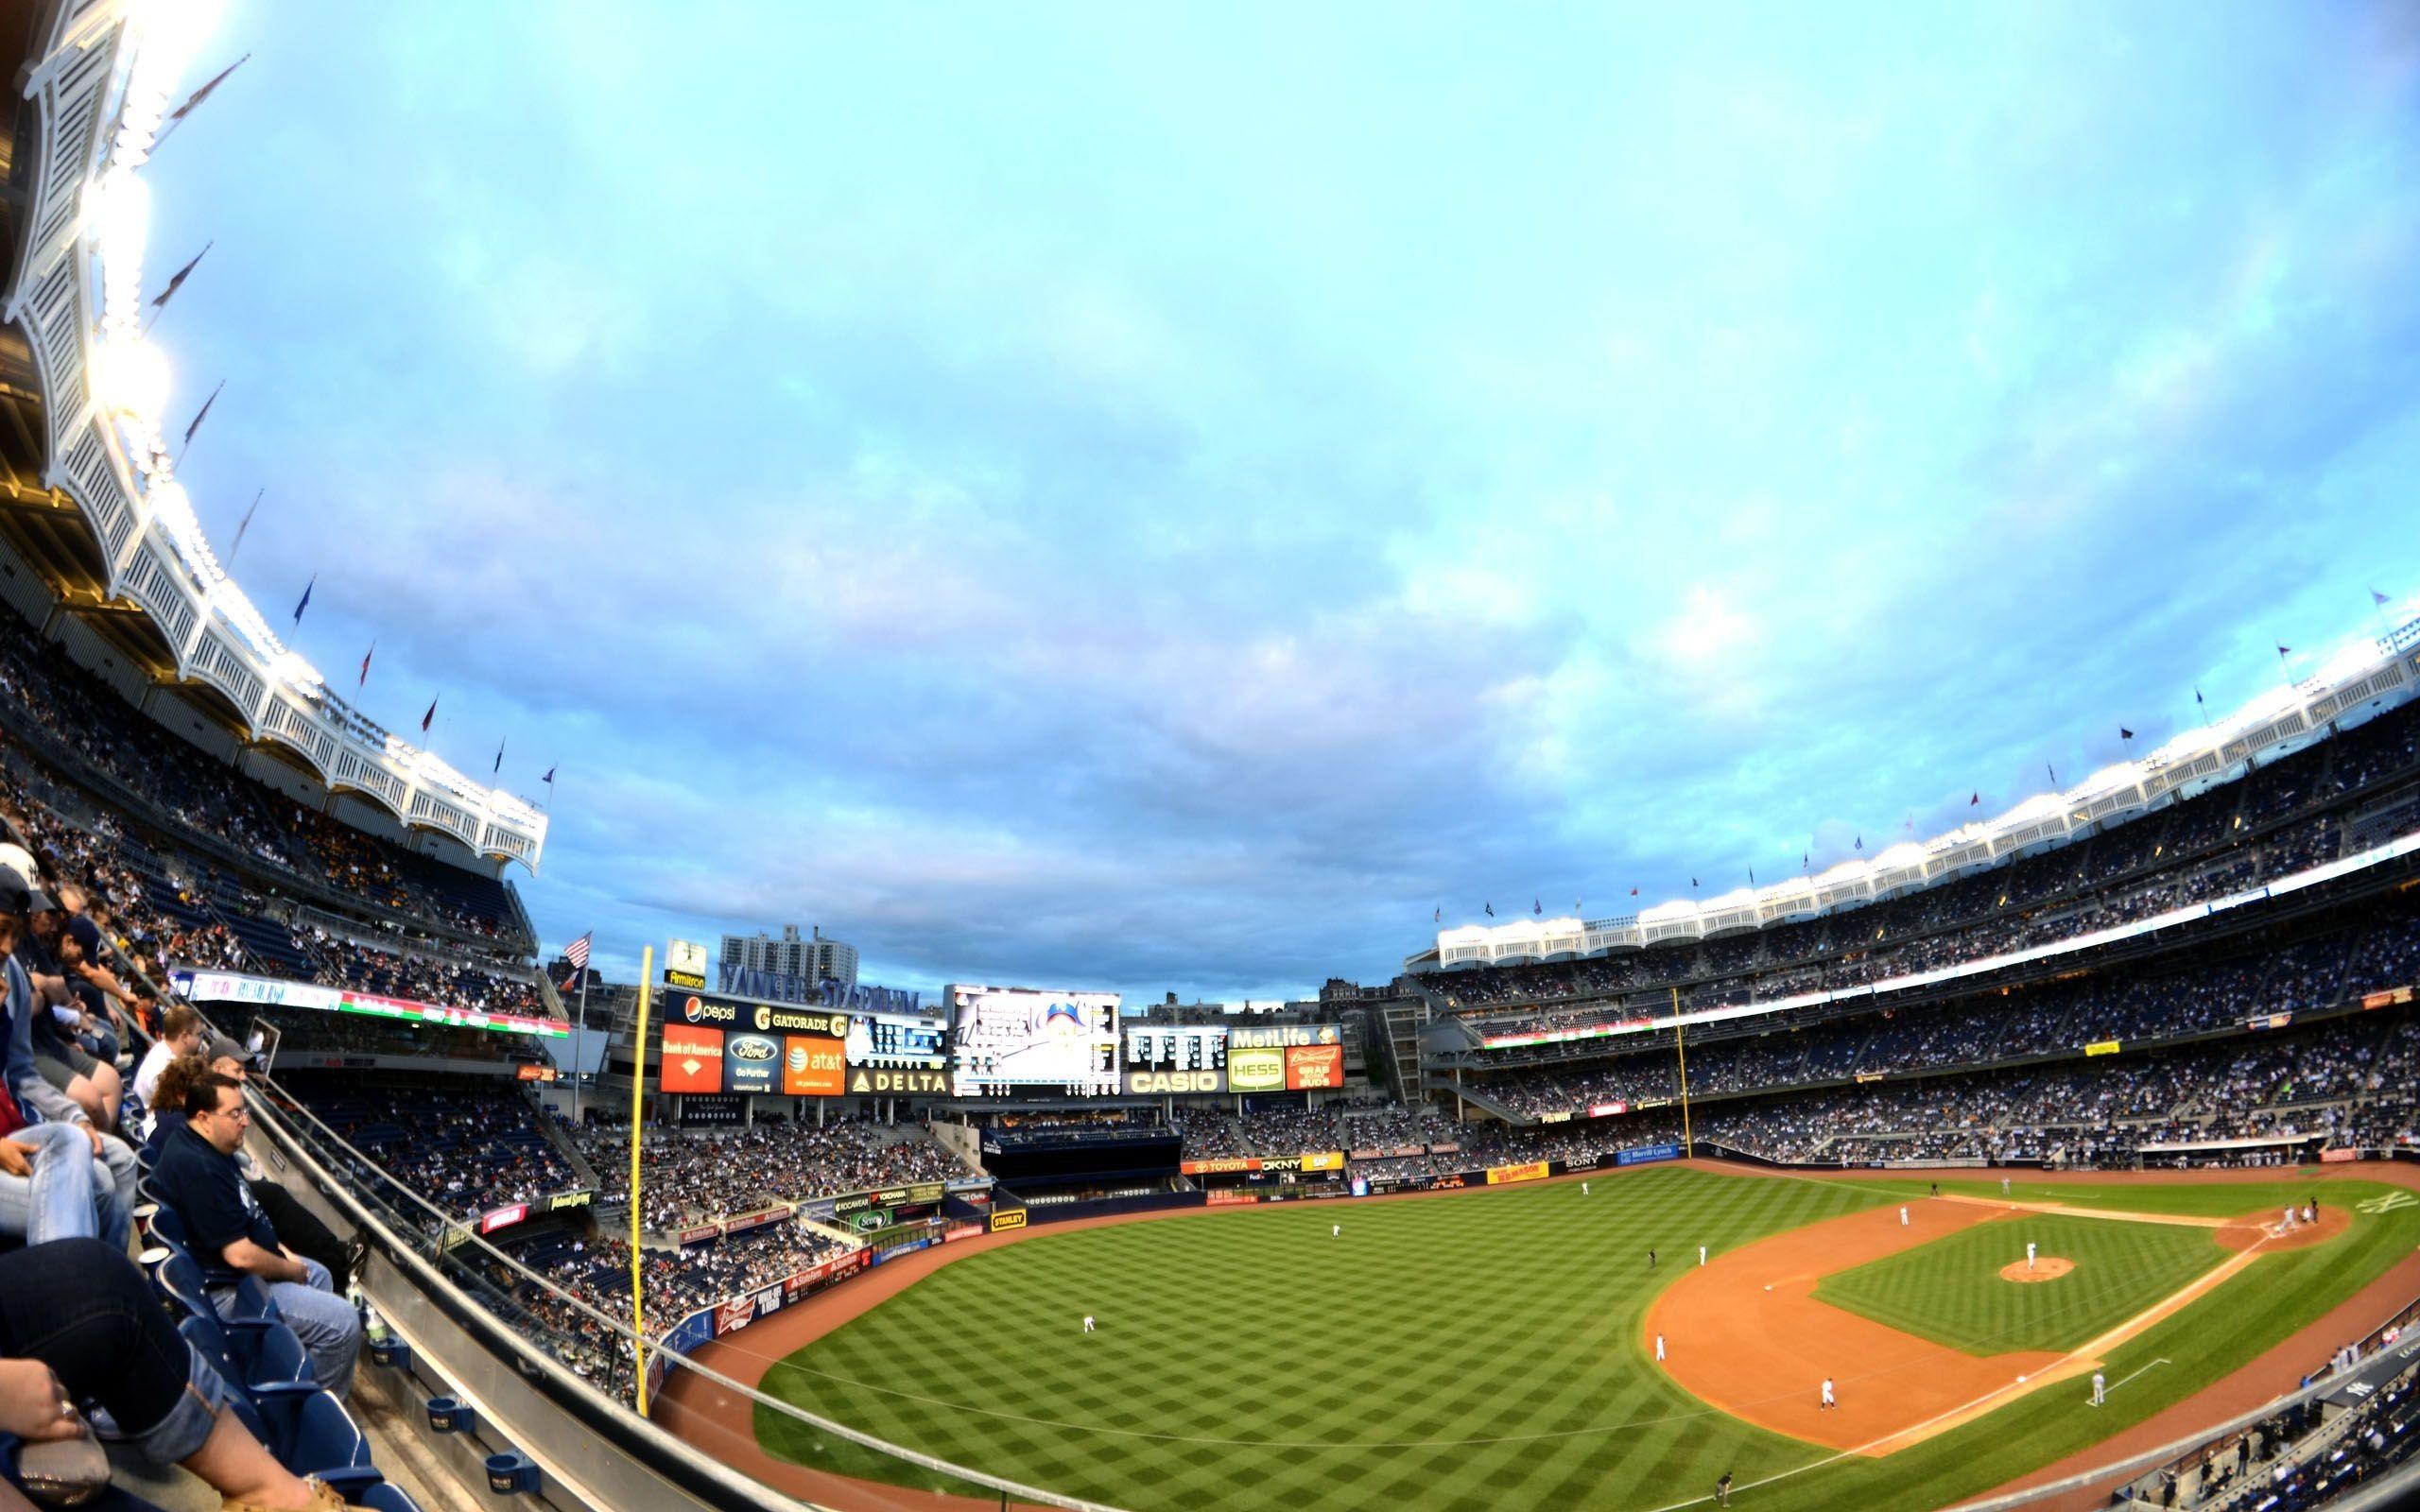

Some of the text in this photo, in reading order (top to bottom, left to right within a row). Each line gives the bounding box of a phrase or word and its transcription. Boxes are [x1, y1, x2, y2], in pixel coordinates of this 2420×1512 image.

[670, 971, 704, 989] Armitron
[702, 1005, 735, 1021] pepsi
[755, 1006, 845, 1037] G GATORADE G
[1233, 1028, 1310, 1048] MetLife
[663, 1040, 722, 1057] Bank of America
[739, 1040, 769, 1058] Ford
[811, 1052, 841, 1071] at&t
[735, 1068, 769, 1078] Go Further
[1234, 1064, 1279, 1076] HESS
[1299, 1066, 1329, 1074] GRAB
[876, 1074, 946, 1091] DELTA
[1132, 1072, 1218, 1093] CASIO
[1300, 1078, 1330, 1088] BUDS
[1633, 1148, 1652, 1158] Merrill
[1653, 1147, 1671, 1157] Lynch
[1210, 1160, 1248, 1171] TOYOTA
[1261, 1160, 1301, 1172] DKNY
[1566, 1157, 1599, 1168] SONY
[879, 1191, 907, 1201] YOKOHAMA
[840, 1198, 869, 1211] ROCAWEAR
[994, 1214, 1022, 1227] STANLEY
